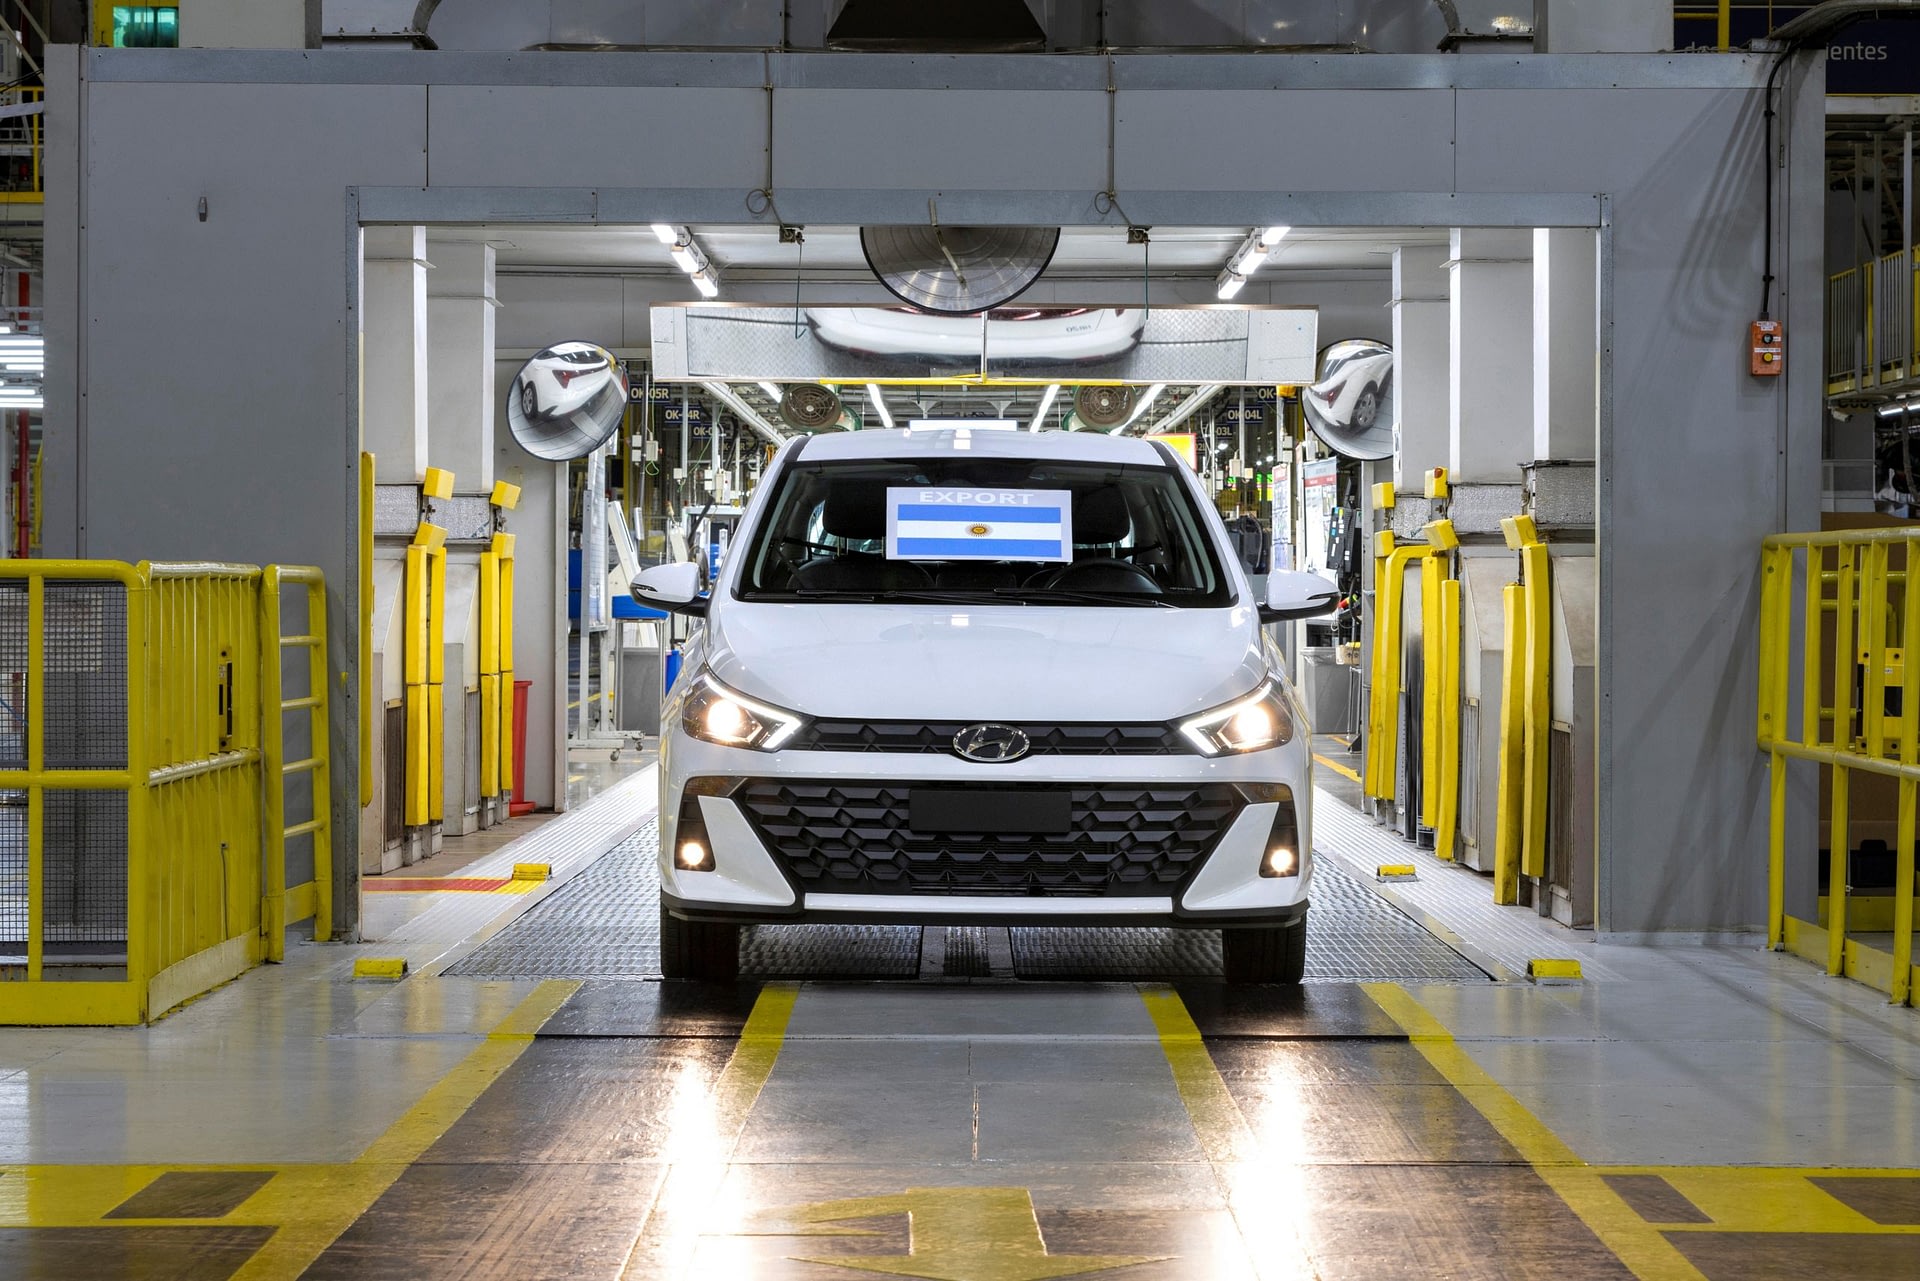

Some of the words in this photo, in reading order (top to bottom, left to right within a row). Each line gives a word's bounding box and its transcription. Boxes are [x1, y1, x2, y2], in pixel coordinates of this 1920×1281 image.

[1825, 42, 1888, 61] ientes
[631, 388, 669, 400] OK05R
[665, 409, 700, 420] OK-4R
[1227, 410, 1262, 420] OK04L
[919, 491, 1035, 505] EXPORT
